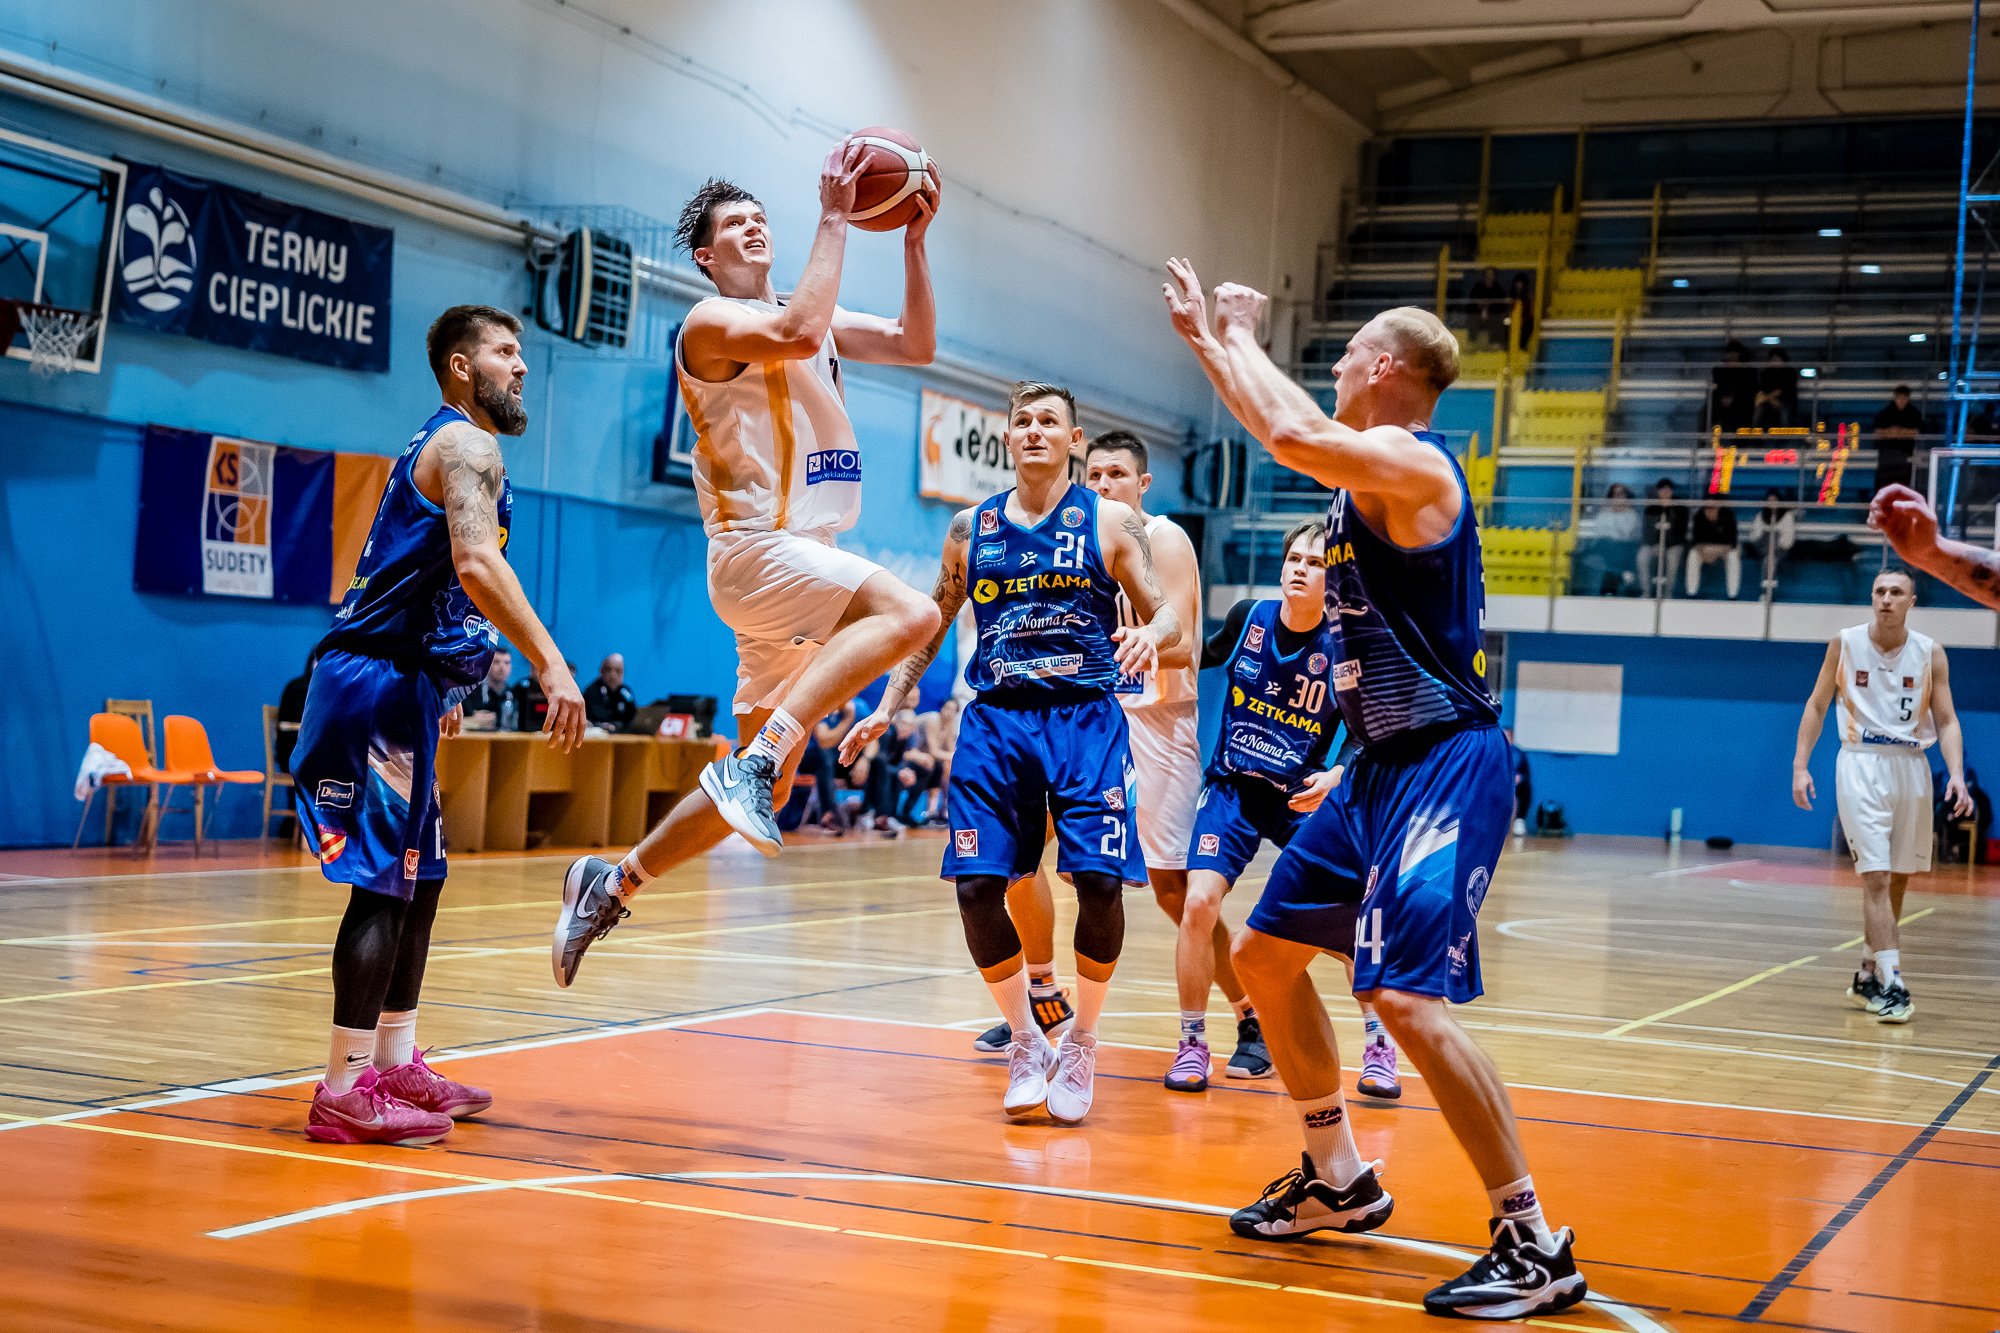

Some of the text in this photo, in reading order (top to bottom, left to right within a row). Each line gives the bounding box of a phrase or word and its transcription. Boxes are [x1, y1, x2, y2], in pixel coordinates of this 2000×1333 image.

[244, 220, 348, 284] TERMY
[208, 271, 376, 345] CIEPLICKIE
[206, 547, 267, 576] SUDETY
[1053, 531, 1086, 569] 21
[1004, 574, 1091, 594] ZETKAMA
[1001, 613, 1061, 633] La Nonna
[1287, 673, 1327, 714] 30
[1899, 697, 1913, 722] 5
[1246, 696, 1321, 735] ZETKAMA
[1231, 728, 1284, 758] La Nonna
[1100, 815, 1127, 860] 21
[1354, 908, 1385, 965] 4
